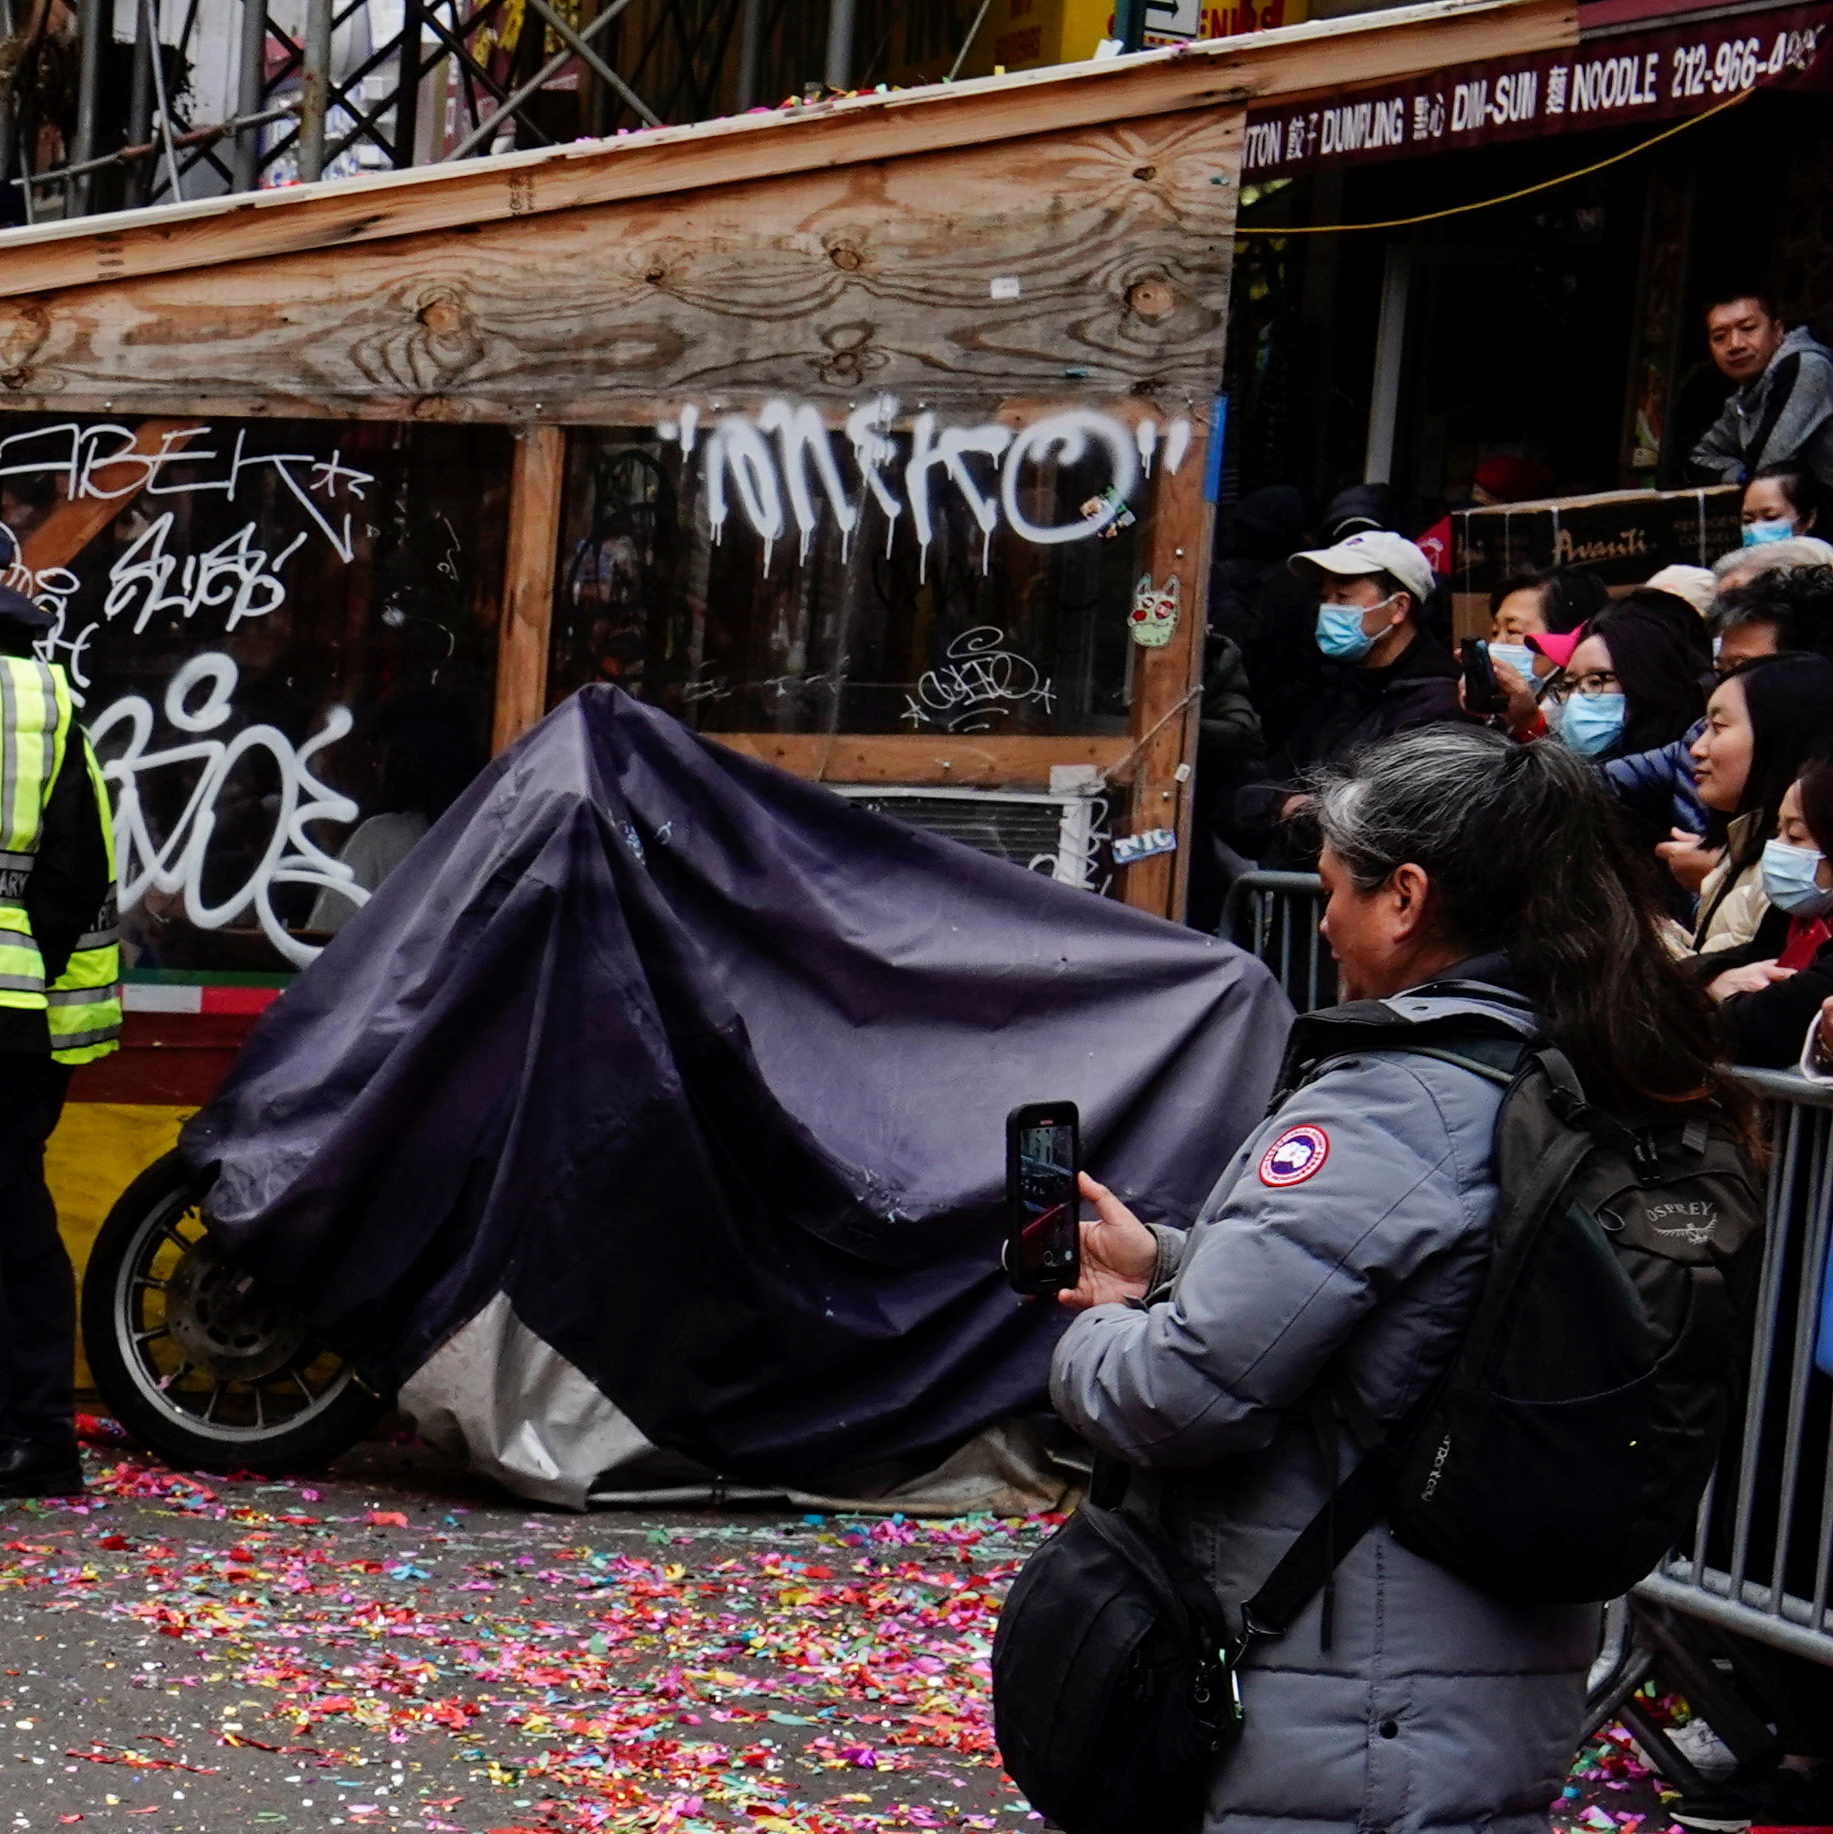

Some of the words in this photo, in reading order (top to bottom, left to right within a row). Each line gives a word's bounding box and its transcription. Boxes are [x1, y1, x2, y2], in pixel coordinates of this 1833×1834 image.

[1320, 97, 1404, 154] DUMPLING
[1570, 52, 1659, 113] NOODLE
[1645, 1201, 1712, 1222] OSPREY
